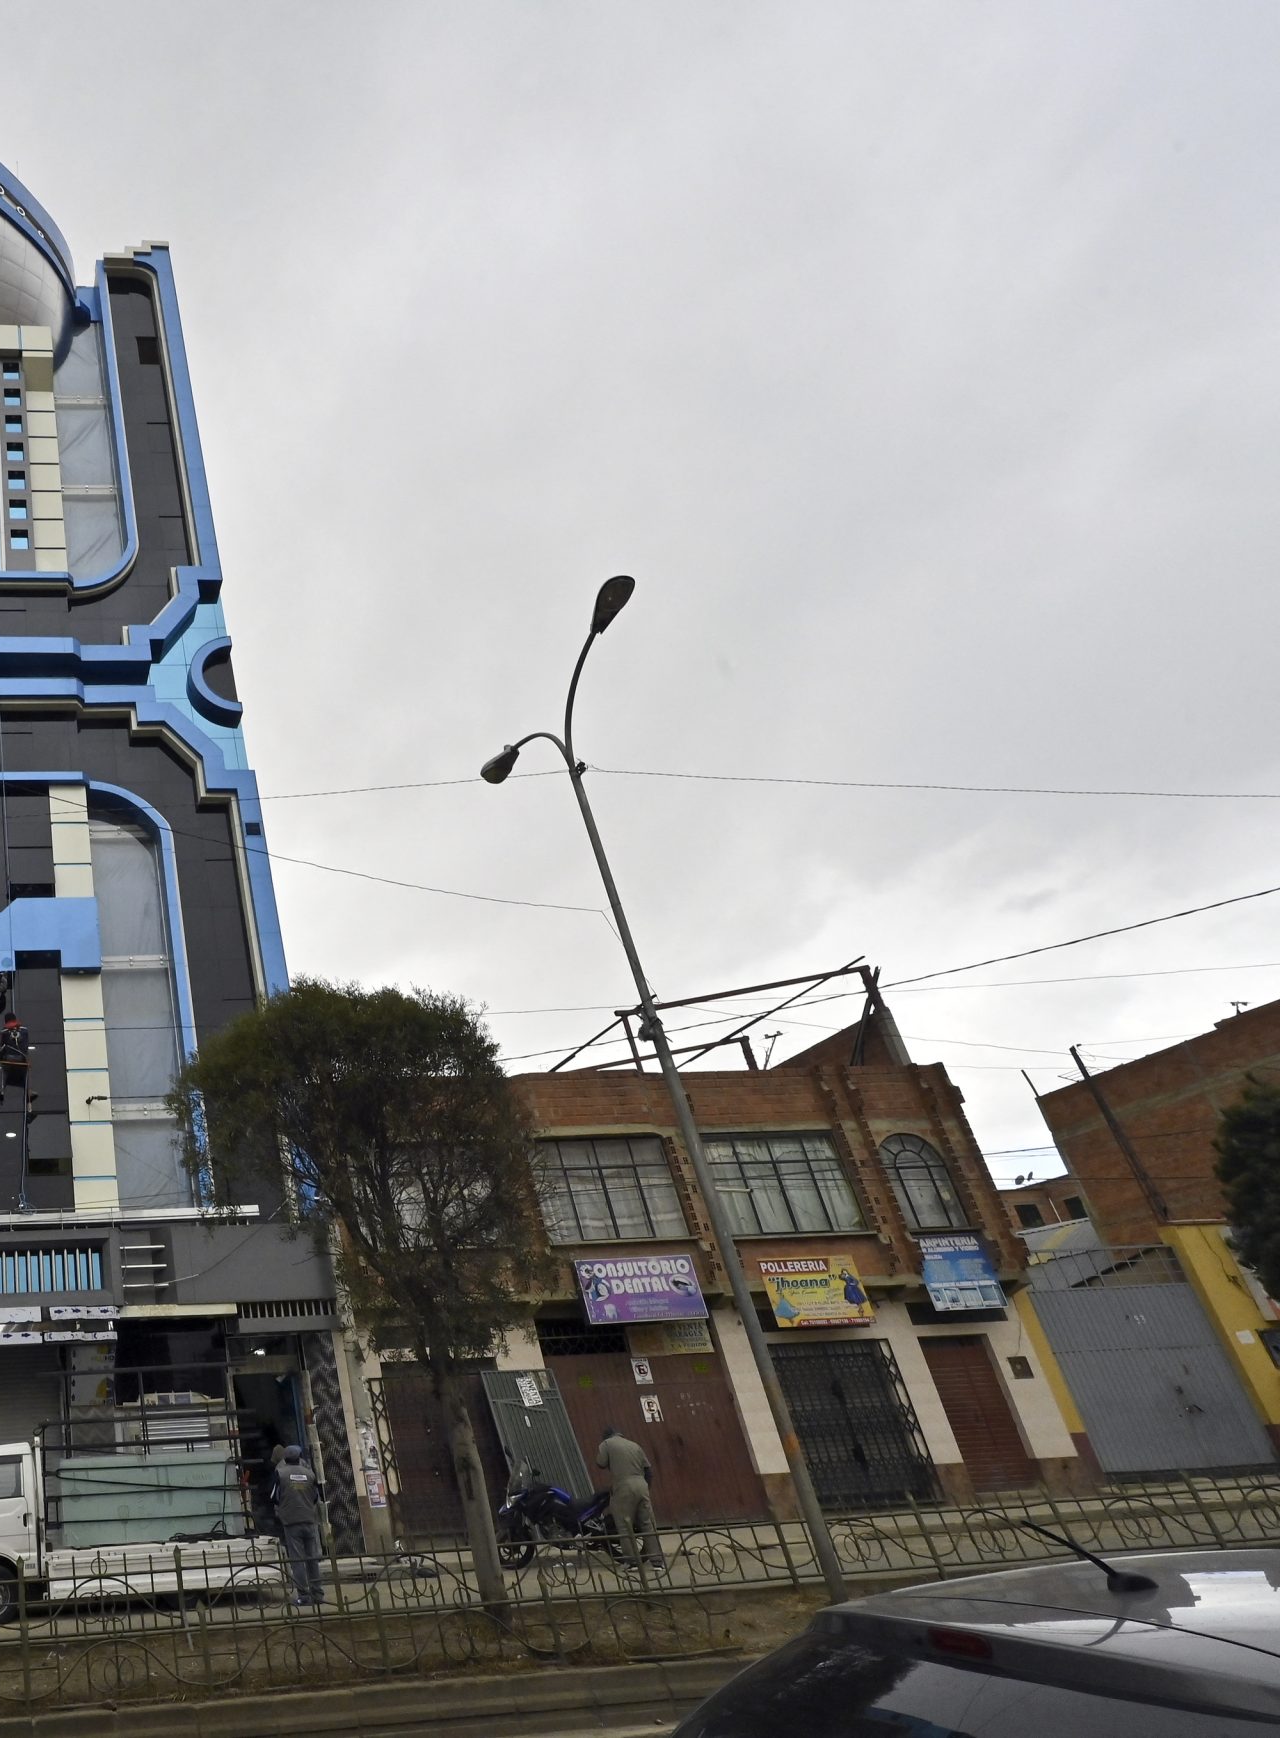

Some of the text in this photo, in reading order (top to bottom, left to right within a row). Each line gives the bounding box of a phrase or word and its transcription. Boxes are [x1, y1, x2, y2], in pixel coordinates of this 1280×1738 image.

[919, 1237, 978, 1248] ARPINTERIA
[580, 1259, 690, 1279] CONSULTORIO
[760, 1260, 827, 1273] POLLERERIA
[611, 1276, 670, 1294] DENTAL
